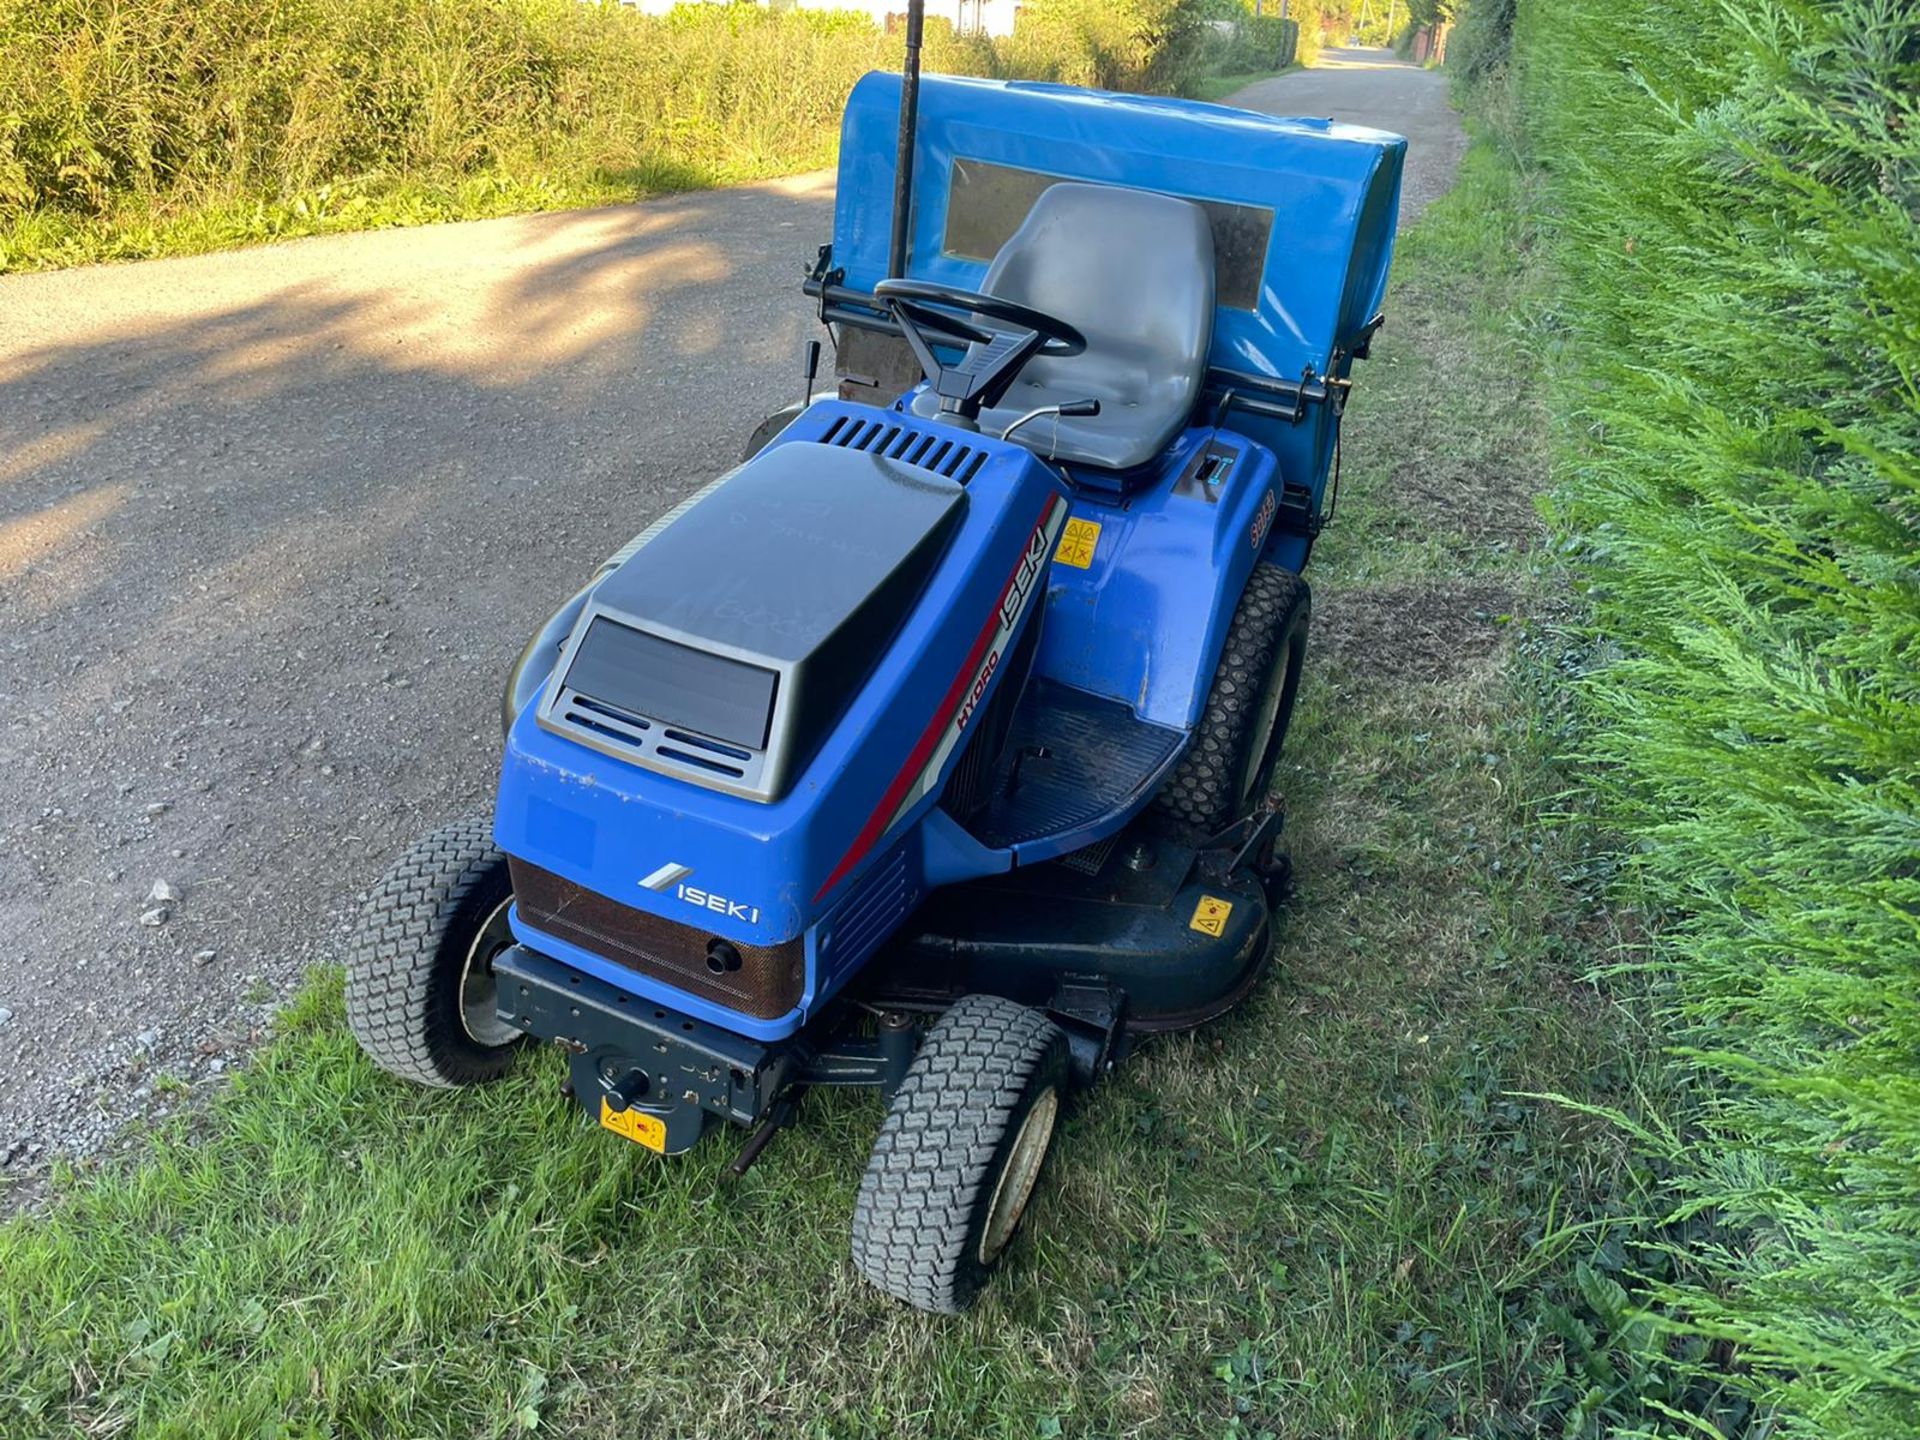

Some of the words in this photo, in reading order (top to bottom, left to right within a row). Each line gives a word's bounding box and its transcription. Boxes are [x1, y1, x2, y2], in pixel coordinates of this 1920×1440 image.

[999, 524, 1048, 631] ISEKI
[957, 651, 998, 730] HYDRO
[678, 883, 758, 924] ISEKI
